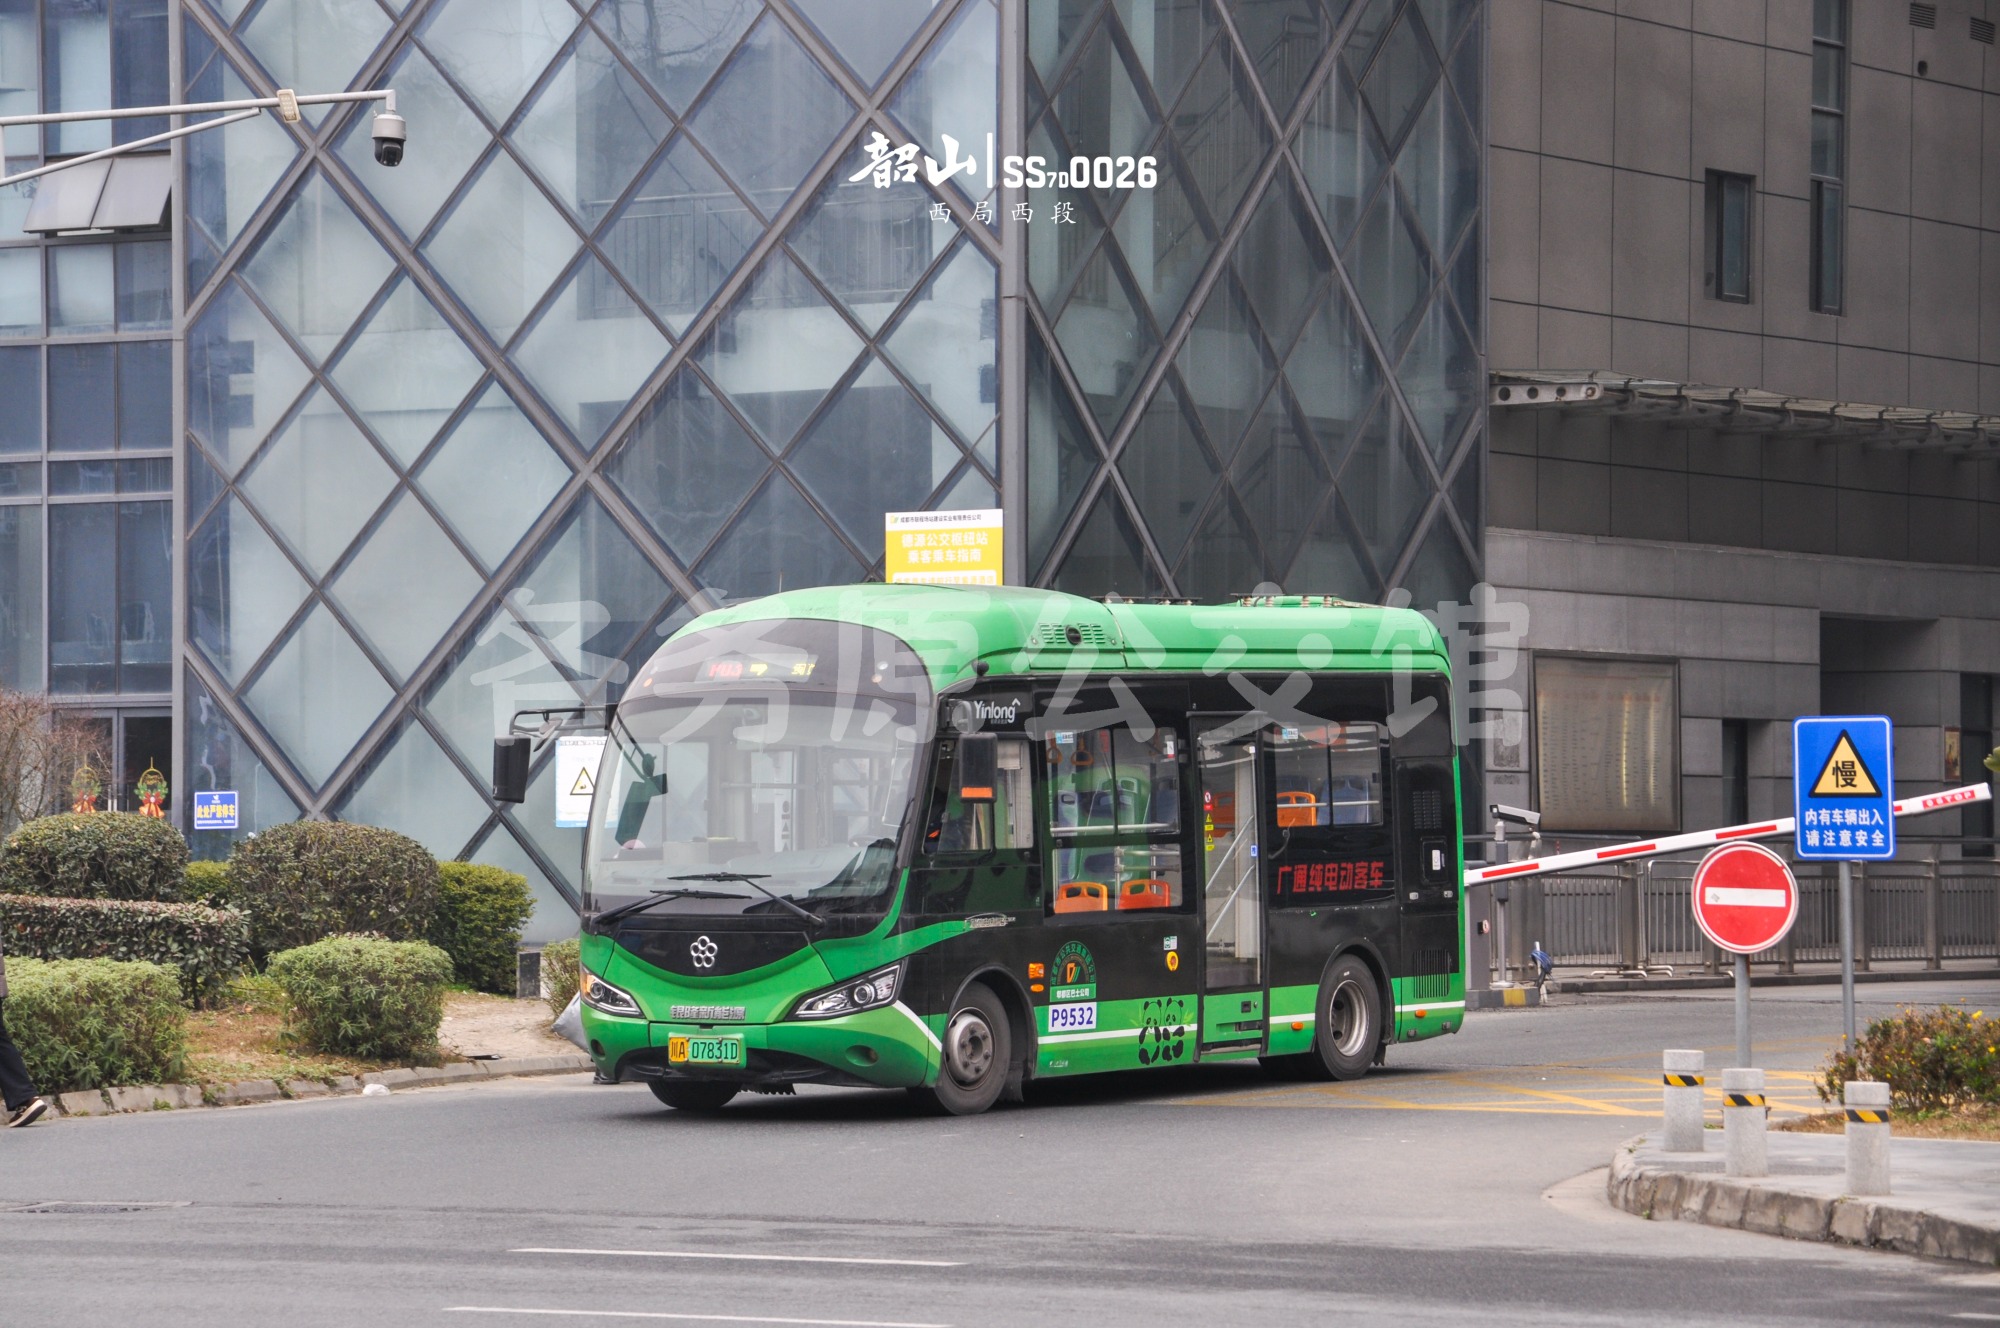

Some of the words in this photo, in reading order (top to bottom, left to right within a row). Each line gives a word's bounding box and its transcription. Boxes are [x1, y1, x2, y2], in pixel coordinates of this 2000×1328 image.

[901, 531, 989, 548] 德源公交枢纽站
[907, 548, 983, 564] 乘客乘车指南
[973, 700, 1016, 723] Yinlong
[1831, 760, 1858, 788] 慢
[1804, 808, 1885, 826] 内有车辆出入
[1805, 829, 1885, 847] 请注意安全
[1277, 861, 1385, 894] 广通纯电动客车
[670, 1004, 746, 1020] 银隆新能源
[1051, 1006, 1094, 1028] P9532
